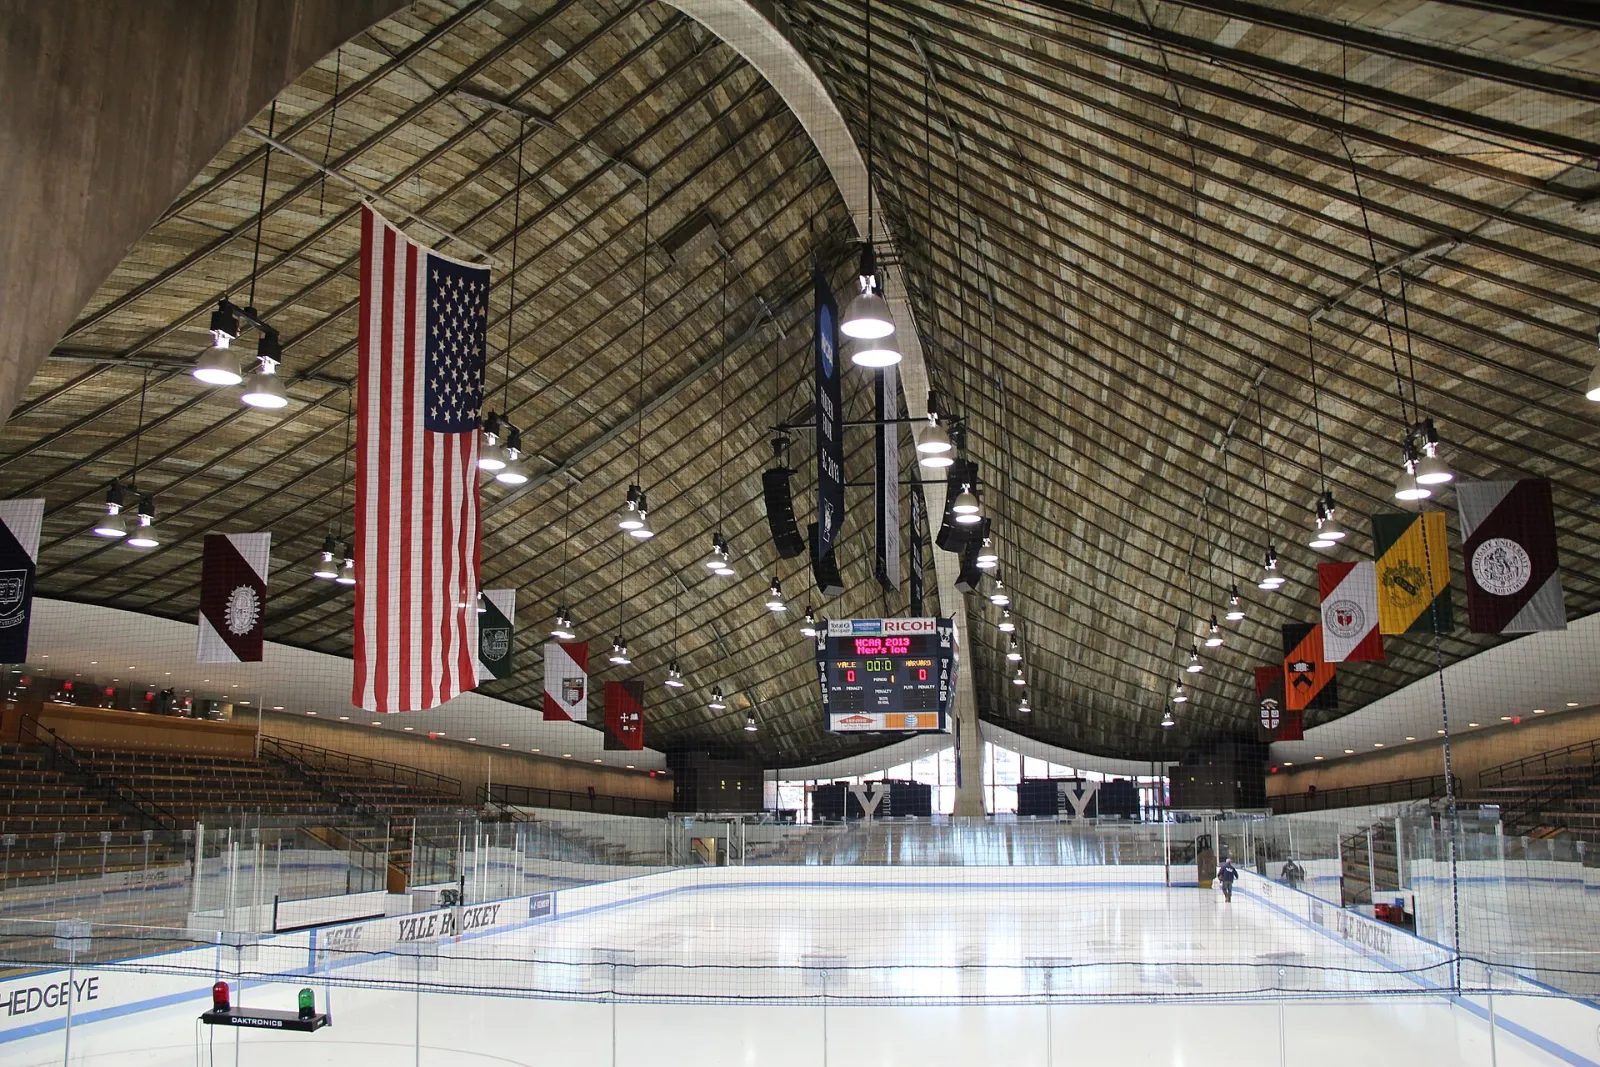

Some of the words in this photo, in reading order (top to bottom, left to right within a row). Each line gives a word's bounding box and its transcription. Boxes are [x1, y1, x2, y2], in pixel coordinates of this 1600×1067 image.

[885, 621, 934, 631] RICOH
[855, 638, 882, 647] NCAA
[885, 637, 910, 646] 2013
[857, 646, 887, 655] Men's
[890, 646, 907, 654] Ice
[847, 670, 855, 682] 0
[918, 669, 926, 681] 0
[939, 658, 949, 701] YALE
[849, 784, 890, 828] Y
[1057, 782, 1101, 826] Y
[398, 914, 438, 941] YALE
[440, 904, 501, 935] HCKEY
[1356, 919, 1392, 954] HOCKEY
[0, 977, 99, 1017] HEDGEYE
[231, 1017, 283, 1027] DAKTRONICS
